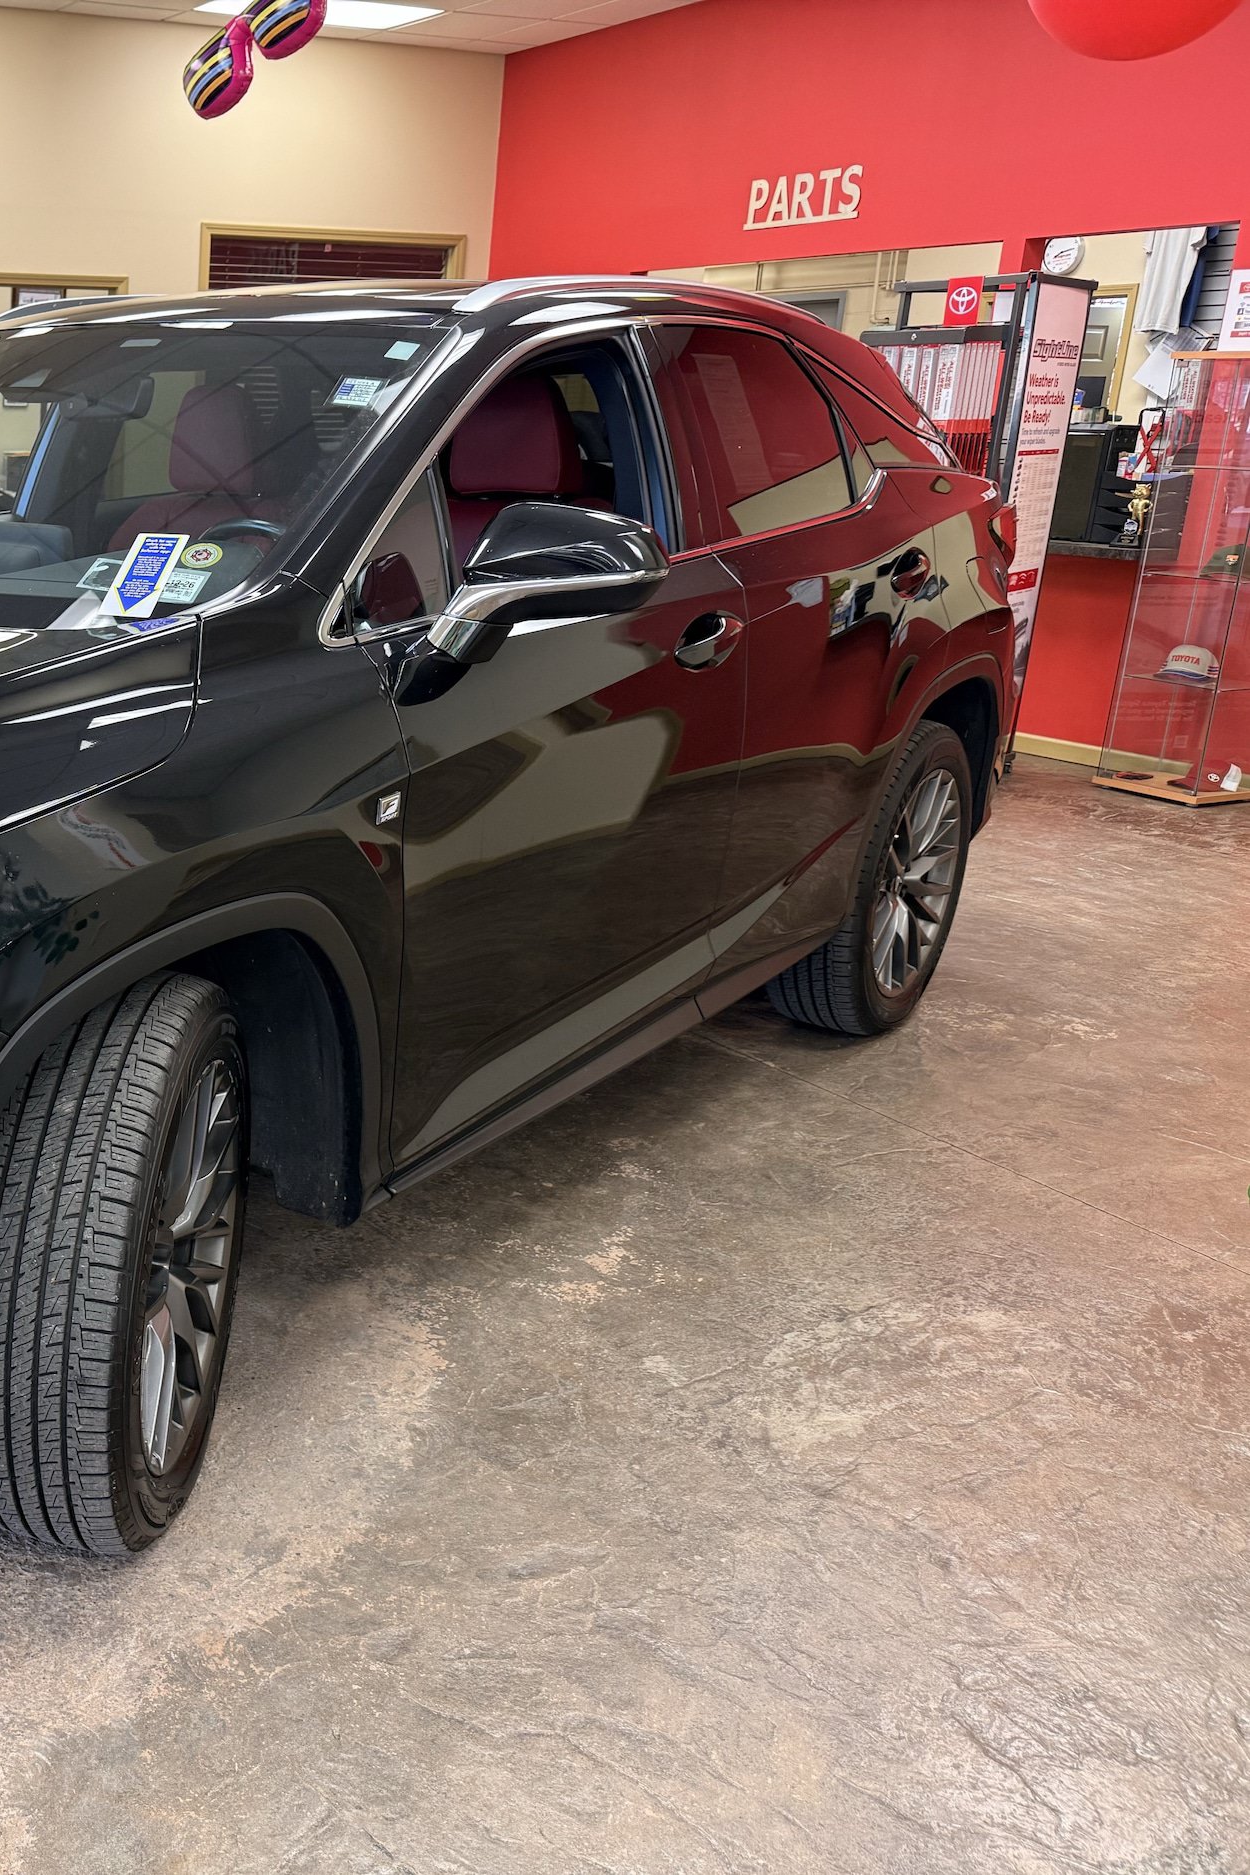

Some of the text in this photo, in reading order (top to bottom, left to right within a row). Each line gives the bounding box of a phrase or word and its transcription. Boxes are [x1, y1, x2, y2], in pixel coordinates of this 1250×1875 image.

[745, 164, 864, 227] PARTS
[1029, 372, 1059, 388] Weather is
[1026, 390, 1066, 408] Unpredictable.
[1024, 408, 1052, 427] Be Ready!
[1171, 654, 1200, 666] TOYOTA
